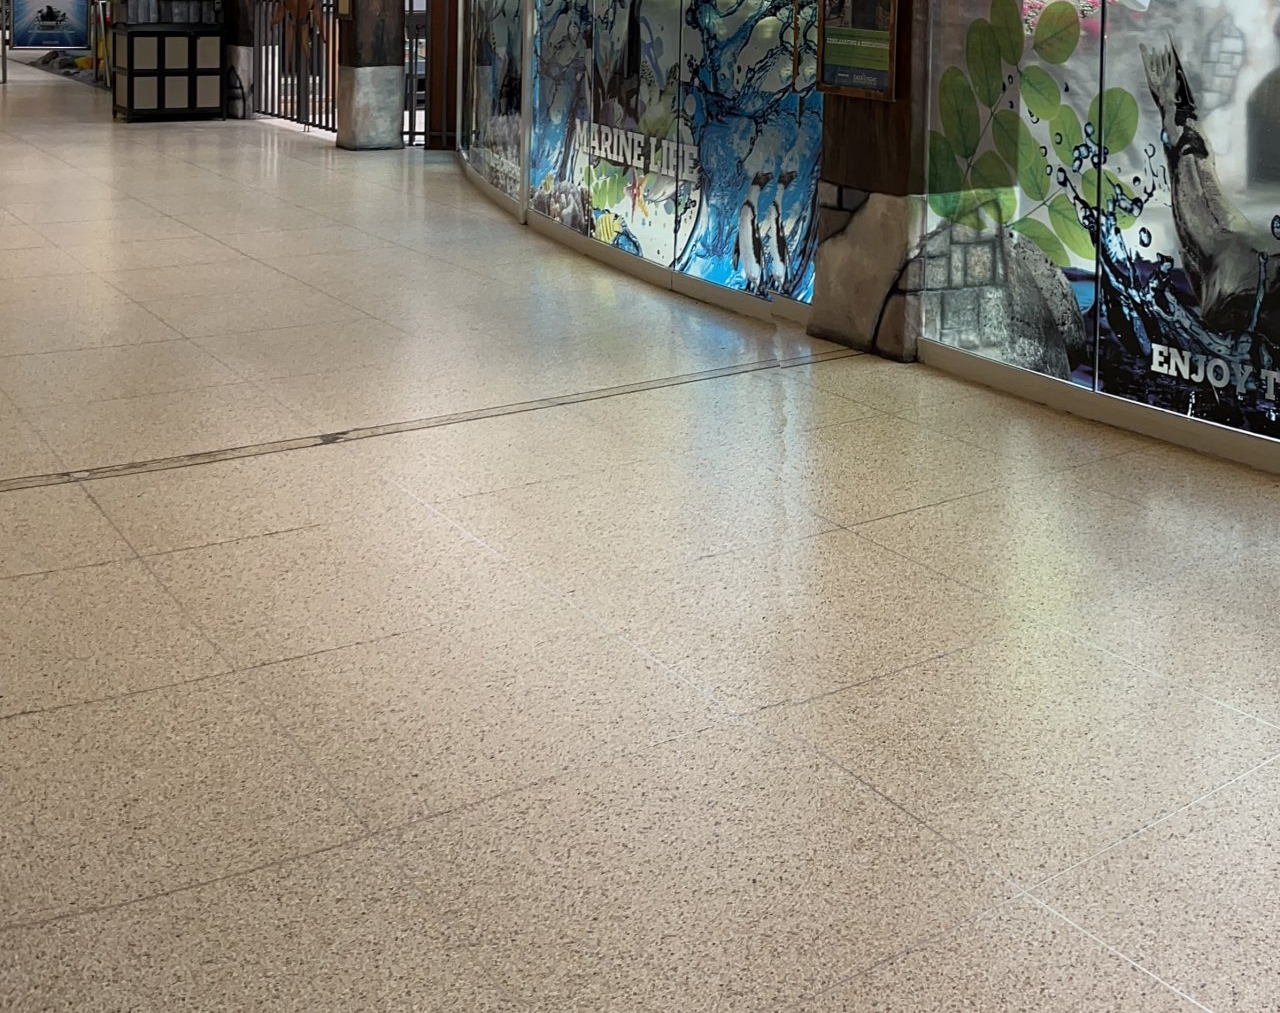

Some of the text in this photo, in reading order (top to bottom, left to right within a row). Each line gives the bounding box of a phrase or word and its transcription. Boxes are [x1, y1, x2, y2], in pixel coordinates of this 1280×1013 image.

[575, 118, 701, 181] MARINE LIFE
[1150, 342, 1254, 394] ENJOY
